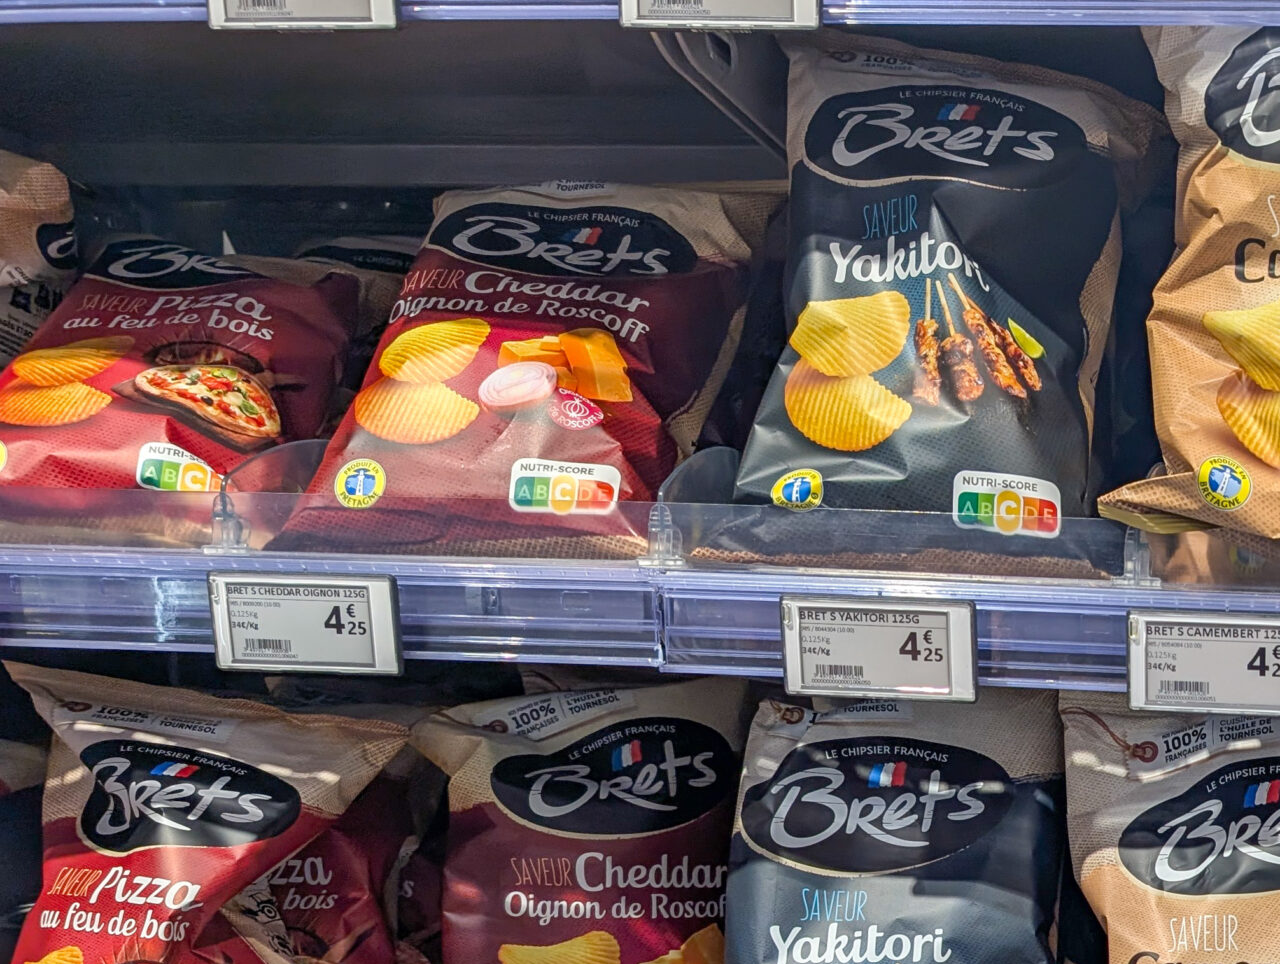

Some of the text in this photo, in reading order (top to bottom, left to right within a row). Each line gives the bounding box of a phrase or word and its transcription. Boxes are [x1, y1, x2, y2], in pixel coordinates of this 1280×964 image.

[832, 103, 1058, 167] Brets
[862, 195, 919, 240] SAVEUR
[453, 216, 671, 275] Brets
[400, 269, 650, 313] SAVEUR Cheddar
[494, 298, 530, 313] de
[536, 299, 650, 343] Roscoff
[962, 476, 1038, 492] NUTRI-SCORE
[1200, 481, 1242, 508] BRETAGNE
[228, 586, 365, 600] BRET S CHEDDAR OIGNON 125G
[325, 605, 367, 636] 4 25
[800, 611, 920, 625] BRET S YAKITORI 125G
[1147, 626, 1173, 636] BRET
[1178, 627, 1183, 637] S
[1186, 627, 1261, 639] CAMEMBERT
[899, 631, 943, 662] 4 25
[1248, 647, 1269, 676] 4
[825, 746, 949, 763] LE CHIPSIER FRANÇAIS
[94, 757, 271, 834] Brets
[769, 768, 985, 848] Brets
[47, 865, 202, 910] SAVEUR Pizza
[801, 888, 867, 921] SAVEUR
[40, 901, 189, 942] au feu de bois
[1168, 915, 1238, 952] SAVEUR
[770, 922, 952, 964] Yakitori
